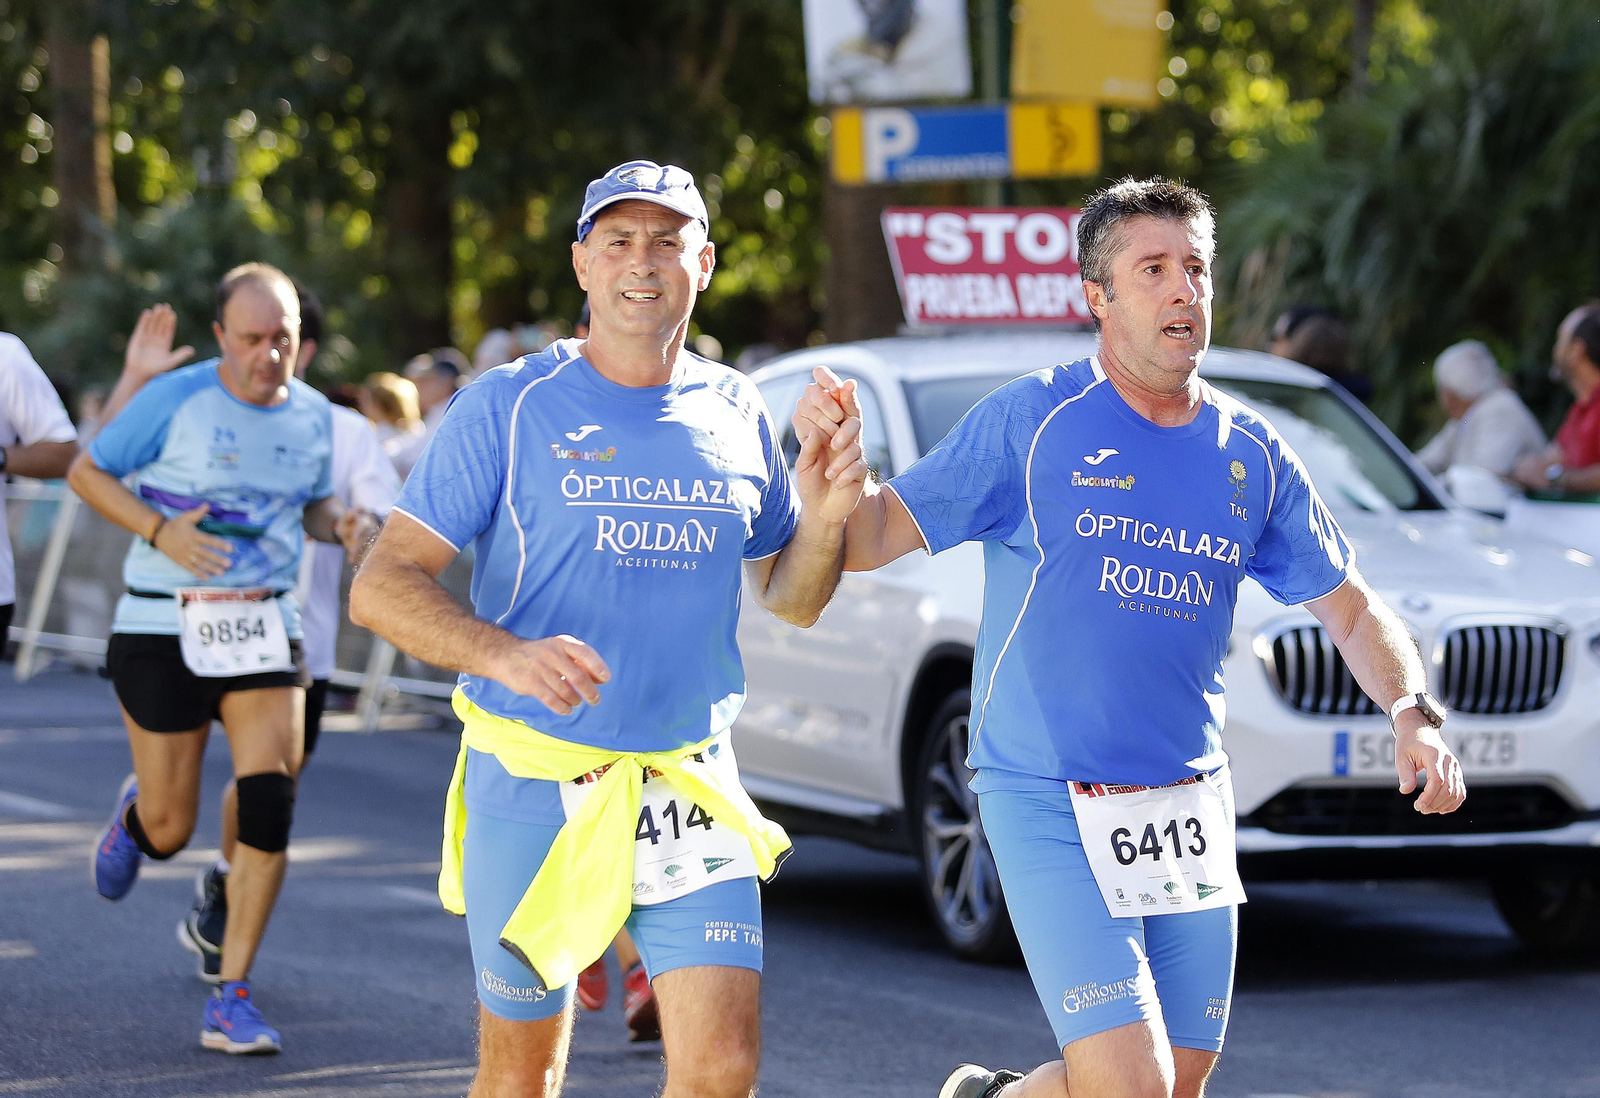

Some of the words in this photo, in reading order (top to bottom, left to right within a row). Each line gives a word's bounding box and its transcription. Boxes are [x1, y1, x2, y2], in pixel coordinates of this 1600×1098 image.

[865, 108, 919, 182] P
[886, 213, 1079, 265] "STO
[1229, 502, 1248, 522] TAC
[1075, 508, 1241, 567] ÓPTICALAZA
[616, 558, 697, 570] ACEITUNAS
[1119, 600, 1198, 622] ACEITUNAS
[199, 616, 266, 646] 9854
[635, 799, 714, 846] 414
[1110, 817, 1207, 866] 6413
[705, 921, 734, 929] CENTRO
[705, 929, 738, 943] PEPE
[744, 931, 763, 947] TAP
[1063, 977, 1139, 1013] GLAMOUR'S
